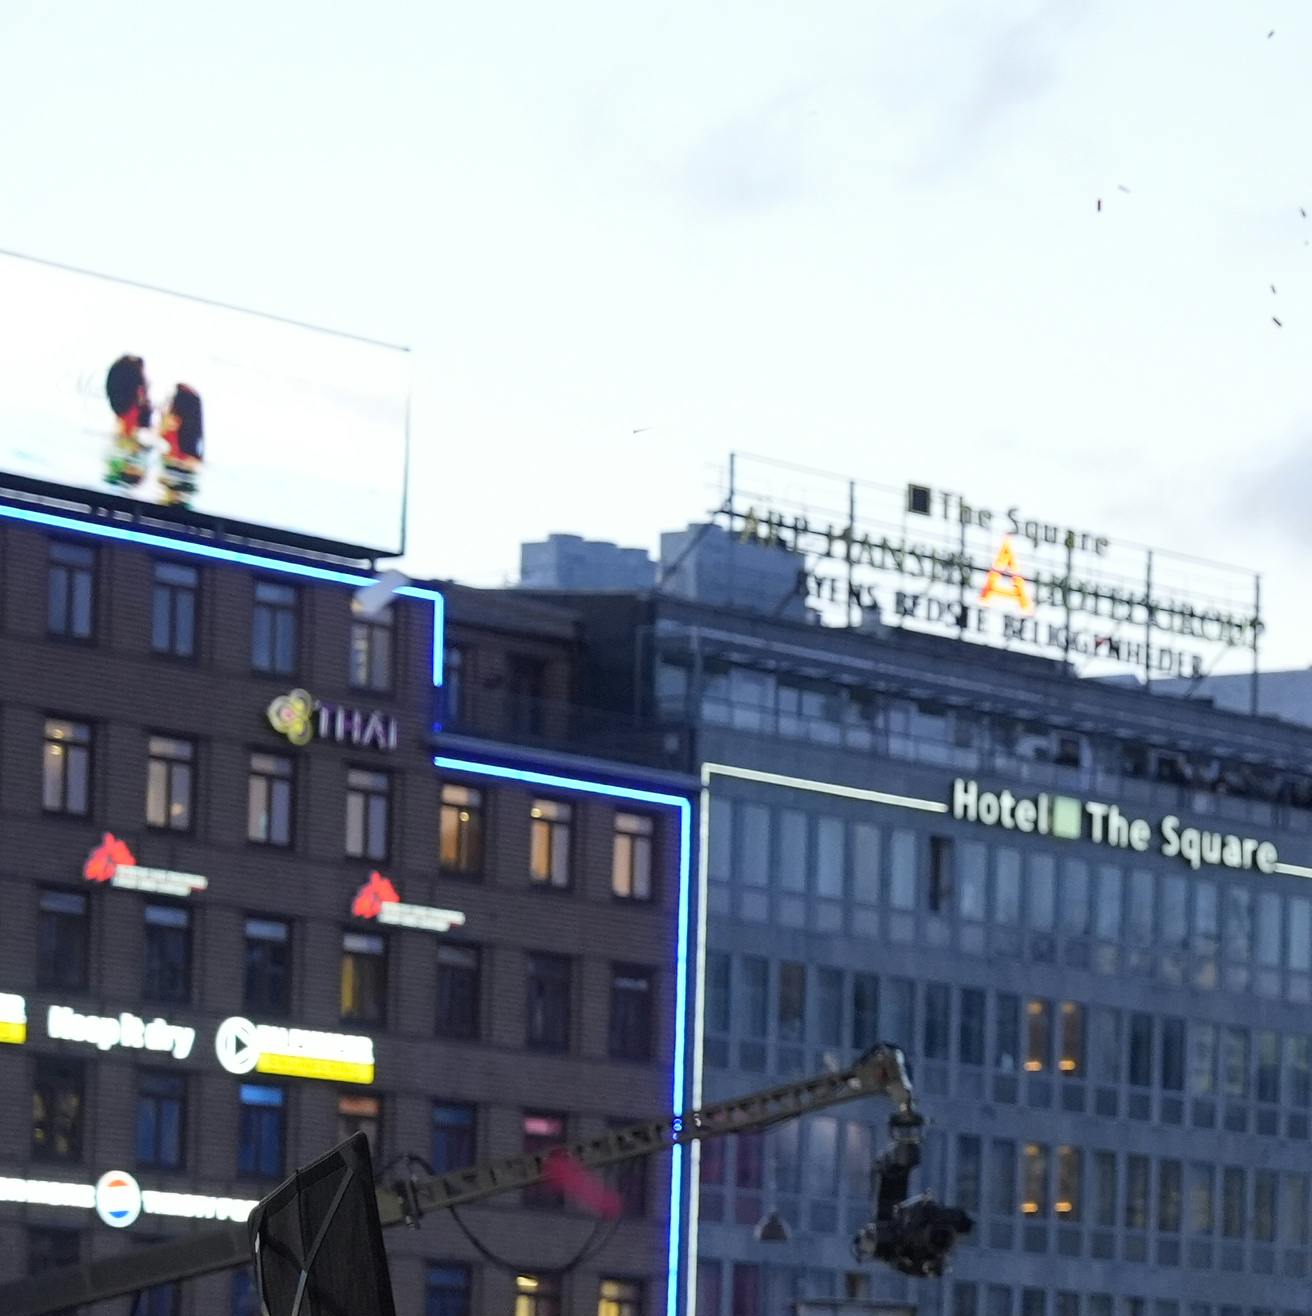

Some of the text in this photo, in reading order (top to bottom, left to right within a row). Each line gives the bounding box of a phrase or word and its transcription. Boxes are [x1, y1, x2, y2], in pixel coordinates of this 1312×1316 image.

[940, 490, 1110, 556] The Square
[317, 702, 398, 750] THAI
[953, 777, 1279, 874] Hotel The Square
